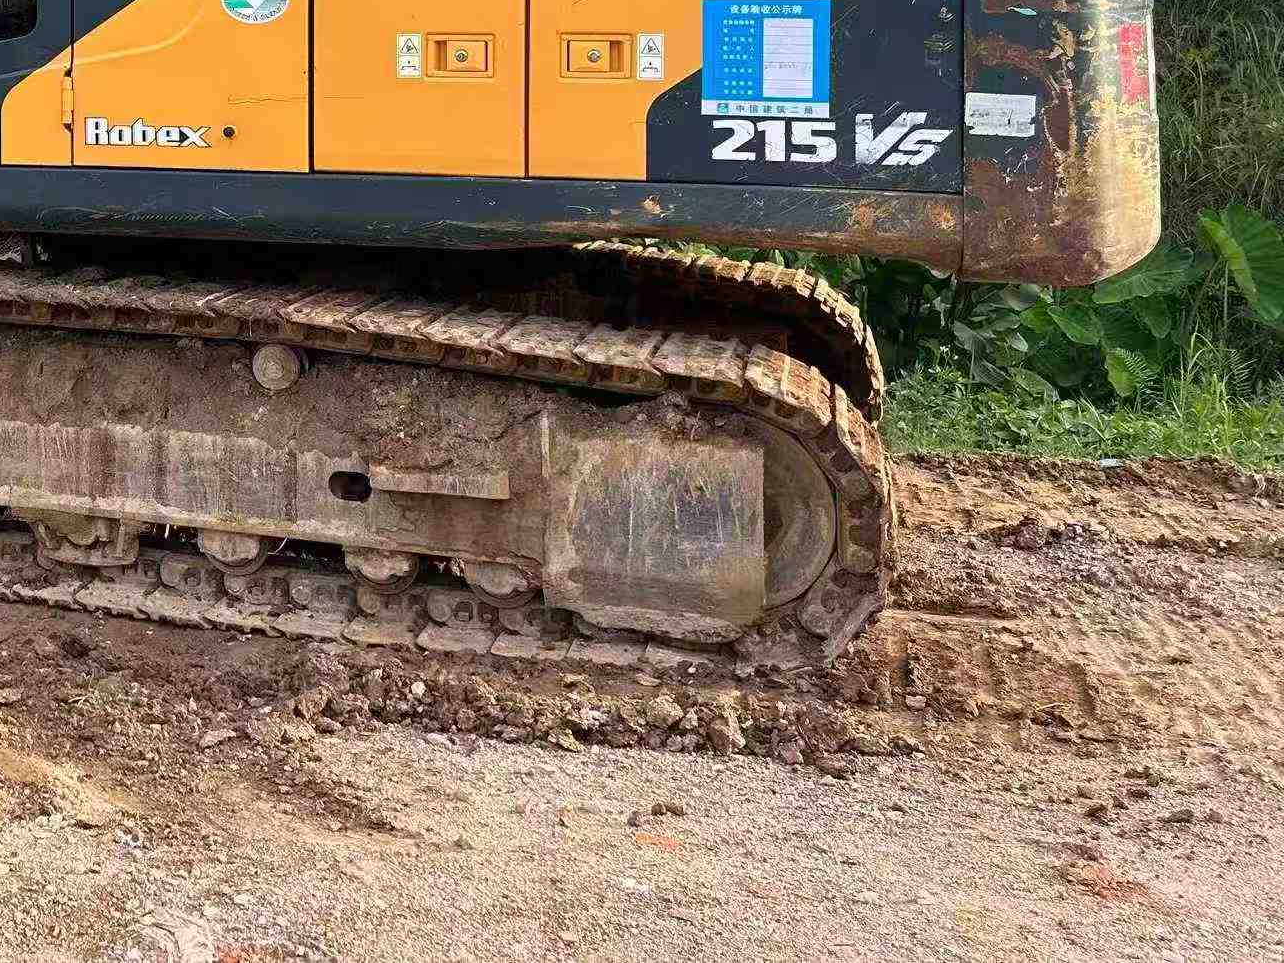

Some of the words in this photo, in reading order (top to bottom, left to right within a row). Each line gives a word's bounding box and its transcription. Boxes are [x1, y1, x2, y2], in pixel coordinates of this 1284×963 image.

[730, 4, 803, 15] 设备验收公示牌
[84, 117, 212, 148] Robex
[711, 119, 837, 163] 215
